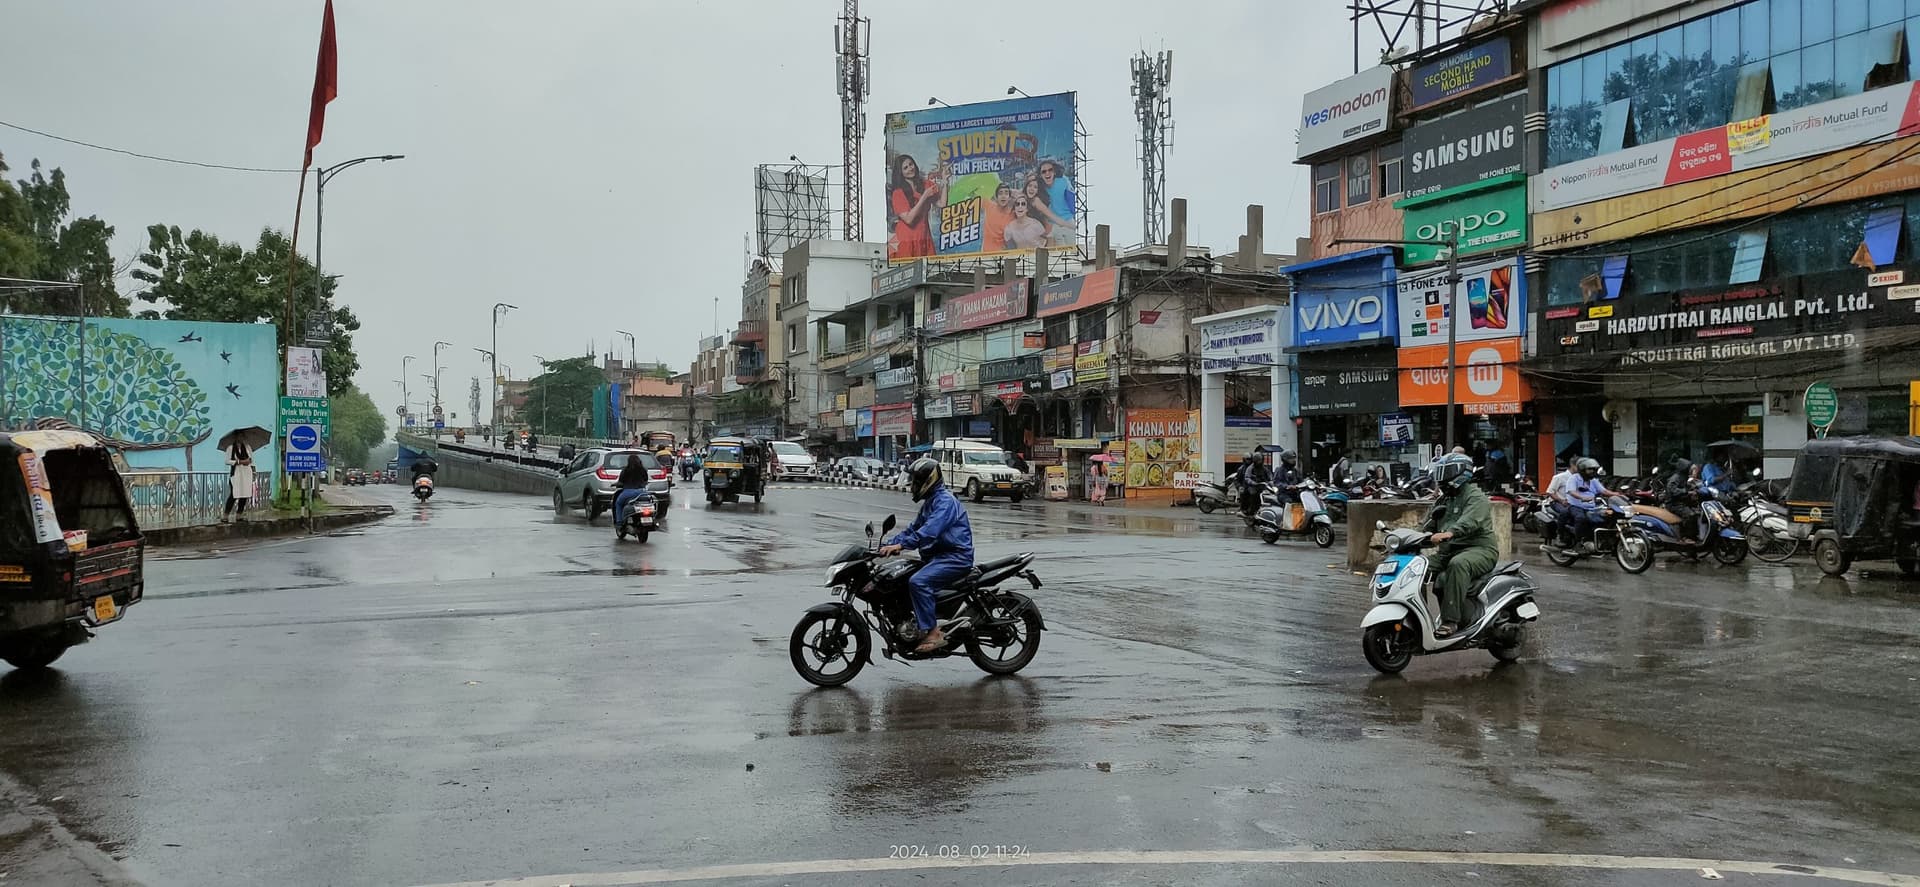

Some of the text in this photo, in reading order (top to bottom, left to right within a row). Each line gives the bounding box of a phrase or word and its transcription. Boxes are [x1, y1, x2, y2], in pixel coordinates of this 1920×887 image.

[1449, 51, 1473, 67] MOBILE
[1424, 55, 1491, 87] SECOND HAND
[1441, 72, 1475, 92] MOBILE
[1304, 87, 1386, 128] yesmadam
[1793, 114, 1824, 133] india
[1824, 107, 1860, 126] Mutual
[1861, 101, 1888, 117] Fund
[916, 123, 940, 133] EASTERN
[961, 118, 983, 128] LARGEST
[984, 114, 1016, 126] WATERPARK
[1018, 112, 1030, 121] AND
[1031, 110, 1051, 120] RESORT
[938, 129, 1020, 161] STUDENT
[1412, 125, 1514, 174] SAMSUNG
[952, 158, 1005, 176] FUN FRENZY
[1479, 163, 1520, 180] THE FONE ZONE
[1561, 154, 1658, 186] Nippon india Mutual Fund
[942, 200, 970, 220] BUY
[941, 214, 968, 233] GET
[940, 223, 979, 250] FREE
[1542, 232, 1589, 246] CLINICS
[1411, 274, 1463, 290] FONE ZOE
[1607, 310, 1704, 336] HARDUTTRAI
[1710, 301, 1788, 325] RANGLAL
[1795, 298, 1830, 316] Pvt.
[1838, 292, 1874, 312] Ltd.
[1560, 336, 1579, 345] CEAT
[1711, 340, 1776, 358] RANGLAL
[1339, 369, 1389, 384] SAMSUNG
[281, 408, 297, 416] Drink
[1465, 403, 1519, 413] THE FONE ZONE
[1129, 421, 1164, 436] KHANA
